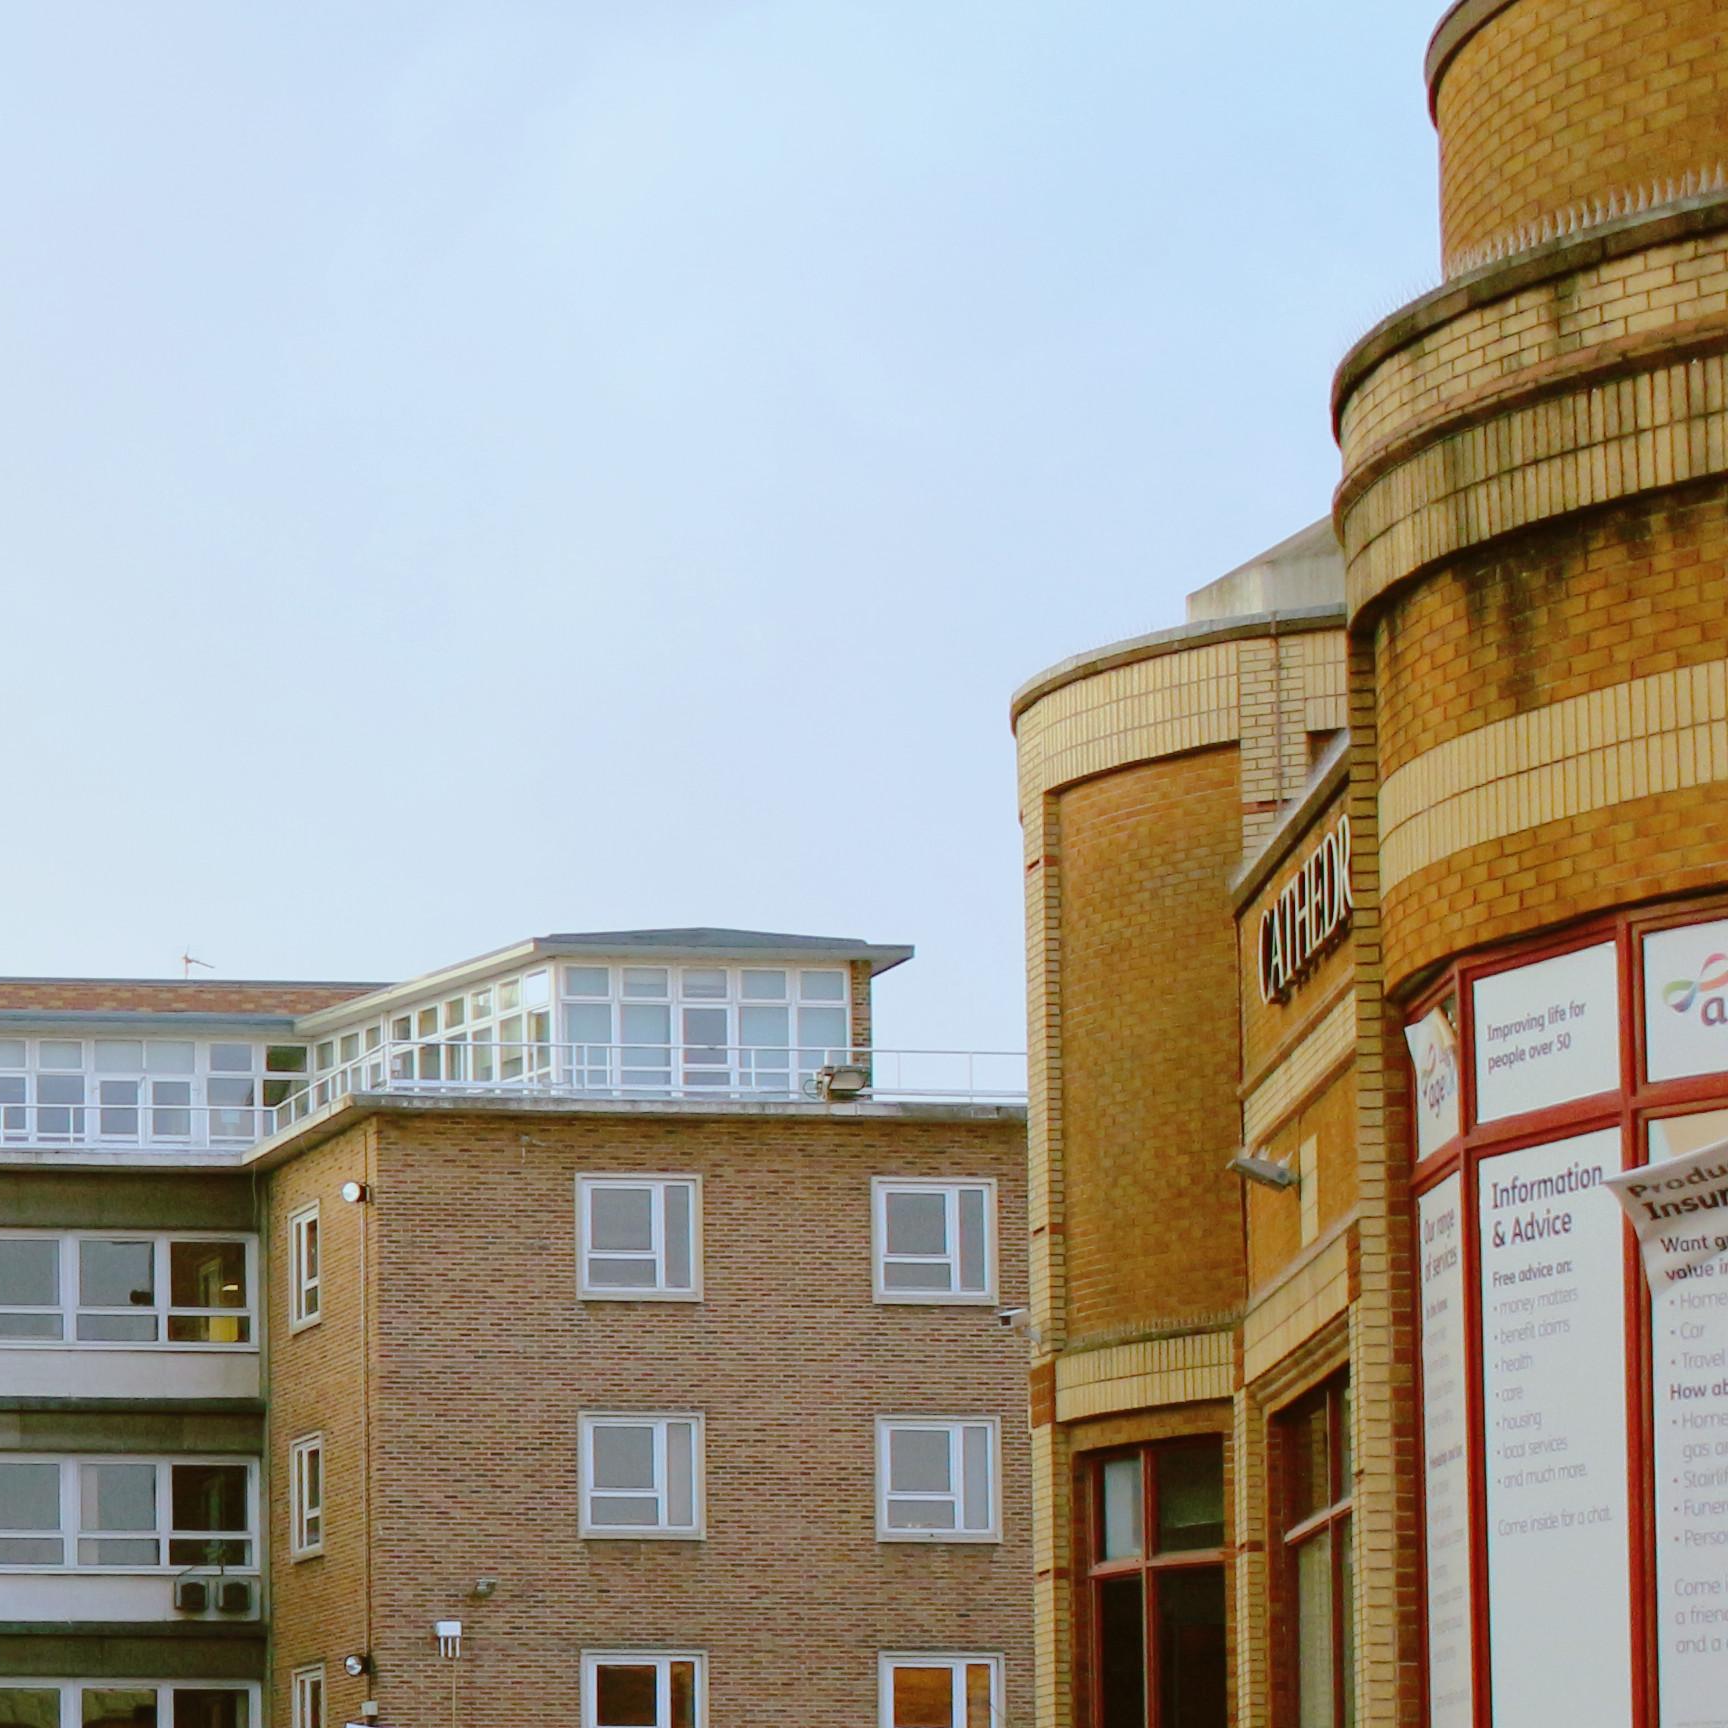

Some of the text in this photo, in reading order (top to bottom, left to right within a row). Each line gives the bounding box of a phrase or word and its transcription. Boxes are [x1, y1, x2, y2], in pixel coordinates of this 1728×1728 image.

[1486, 999, 1587, 1042] Improving life for
[1487, 1031, 1572, 1075] people over 50
[1490, 1160, 1604, 1211] Information
[1491, 1206, 1573, 1248] & Advice
[1660, 1236, 1709, 1254] Want
[1492, 1271, 1516, 1289] Free
[1518, 1262, 1554, 1283] advice
[1665, 1263, 1714, 1281] value
[1499, 1287, 1578, 1316] money matters
[1680, 1321, 1705, 1340] Car
[1682, 1348, 1727, 1369] Travel
[1669, 1382, 1707, 1401] How
[1681, 1411, 1728, 1430] Home
[1675, 1579, 1721, 1598] Come
[1675, 1636, 1707, 1655] and
